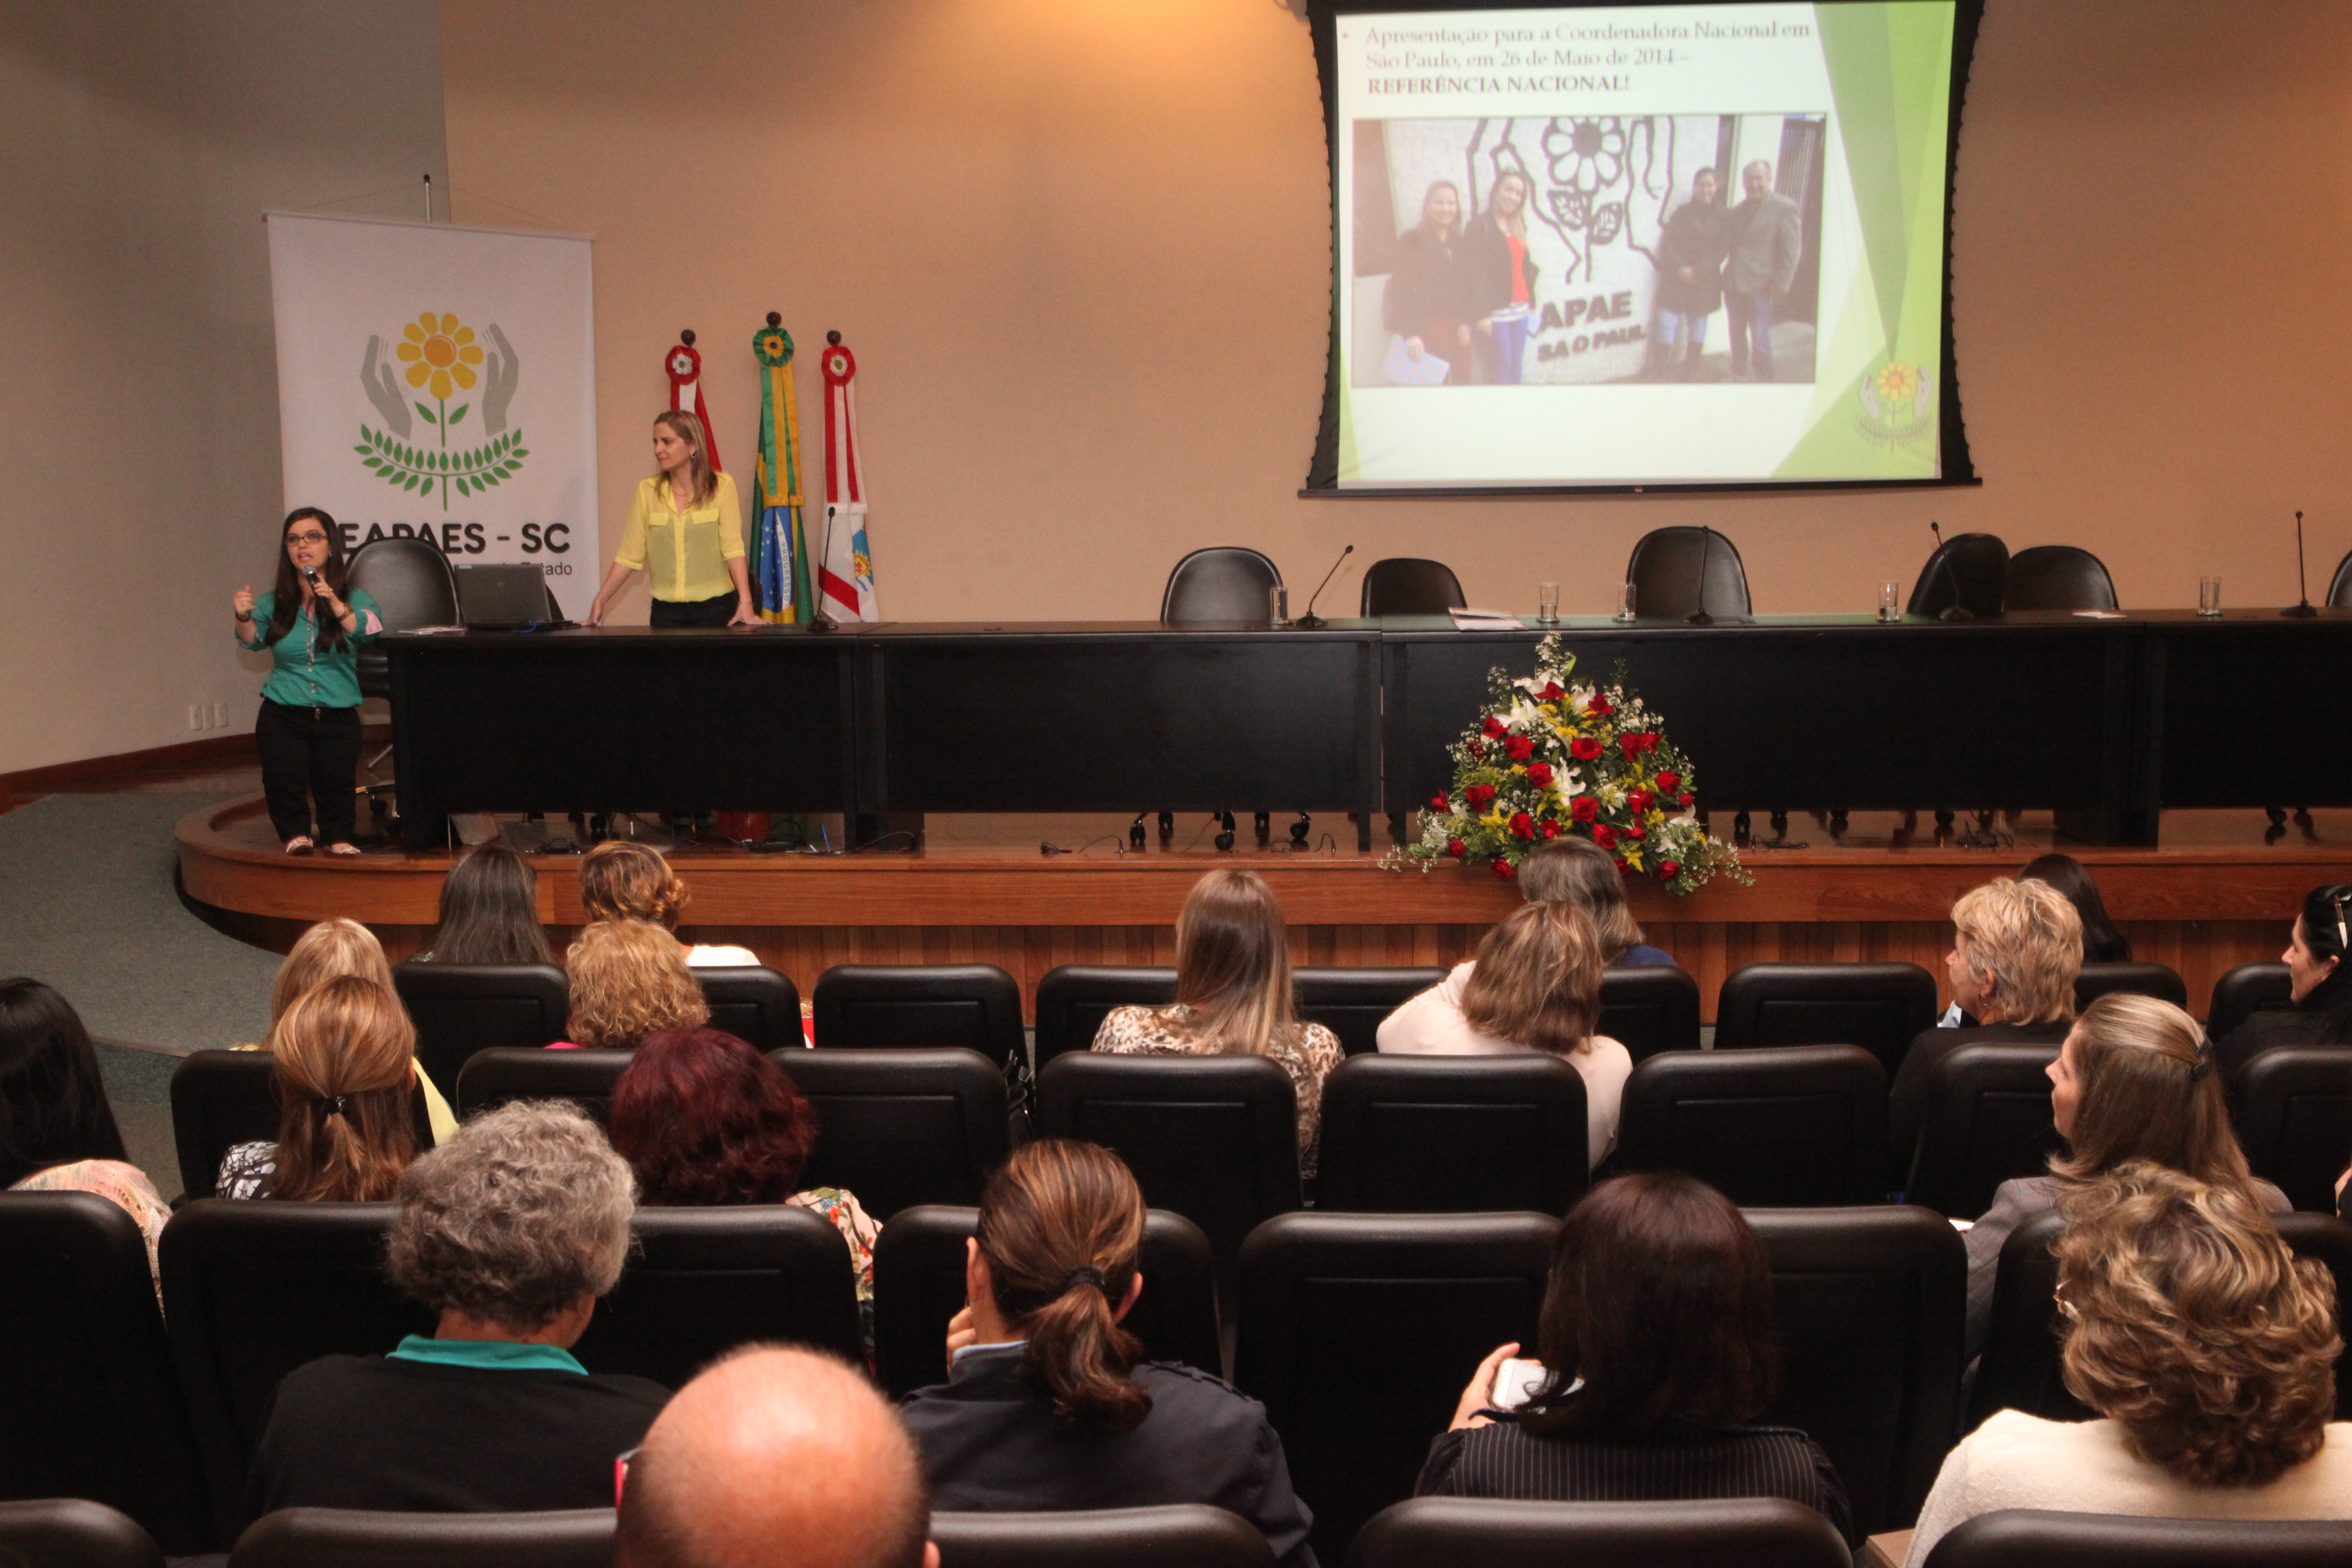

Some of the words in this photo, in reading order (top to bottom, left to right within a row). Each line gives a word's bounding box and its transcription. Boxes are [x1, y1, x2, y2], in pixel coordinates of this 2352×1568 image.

[1366, 26, 1488, 48] Apresentação
[1494, 29, 1533, 46] para
[1540, 29, 1550, 41] a
[1555, 22, 1688, 41] Coordenadora
[1694, 20, 1776, 39] Nacional
[1781, 24, 1810, 38] em
[1366, 52, 1399, 69] São
[1405, 51, 1461, 69] Paulo,
[1467, 55, 1494, 68] em
[1500, 51, 1521, 68] 26
[1525, 50, 1548, 68] de
[1554, 48, 1600, 67] Maio
[1605, 48, 1628, 66] de
[1634, 47, 1674, 66] 2014
[1367, 74, 1500, 95] REFERÊNCIA
[1507, 74, 1630, 93] NACIONAL!
[1538, 291, 1631, 332] APAE
[521, 522, 570, 554] SC
[780, 542, 790, 602] PROGRESSO
